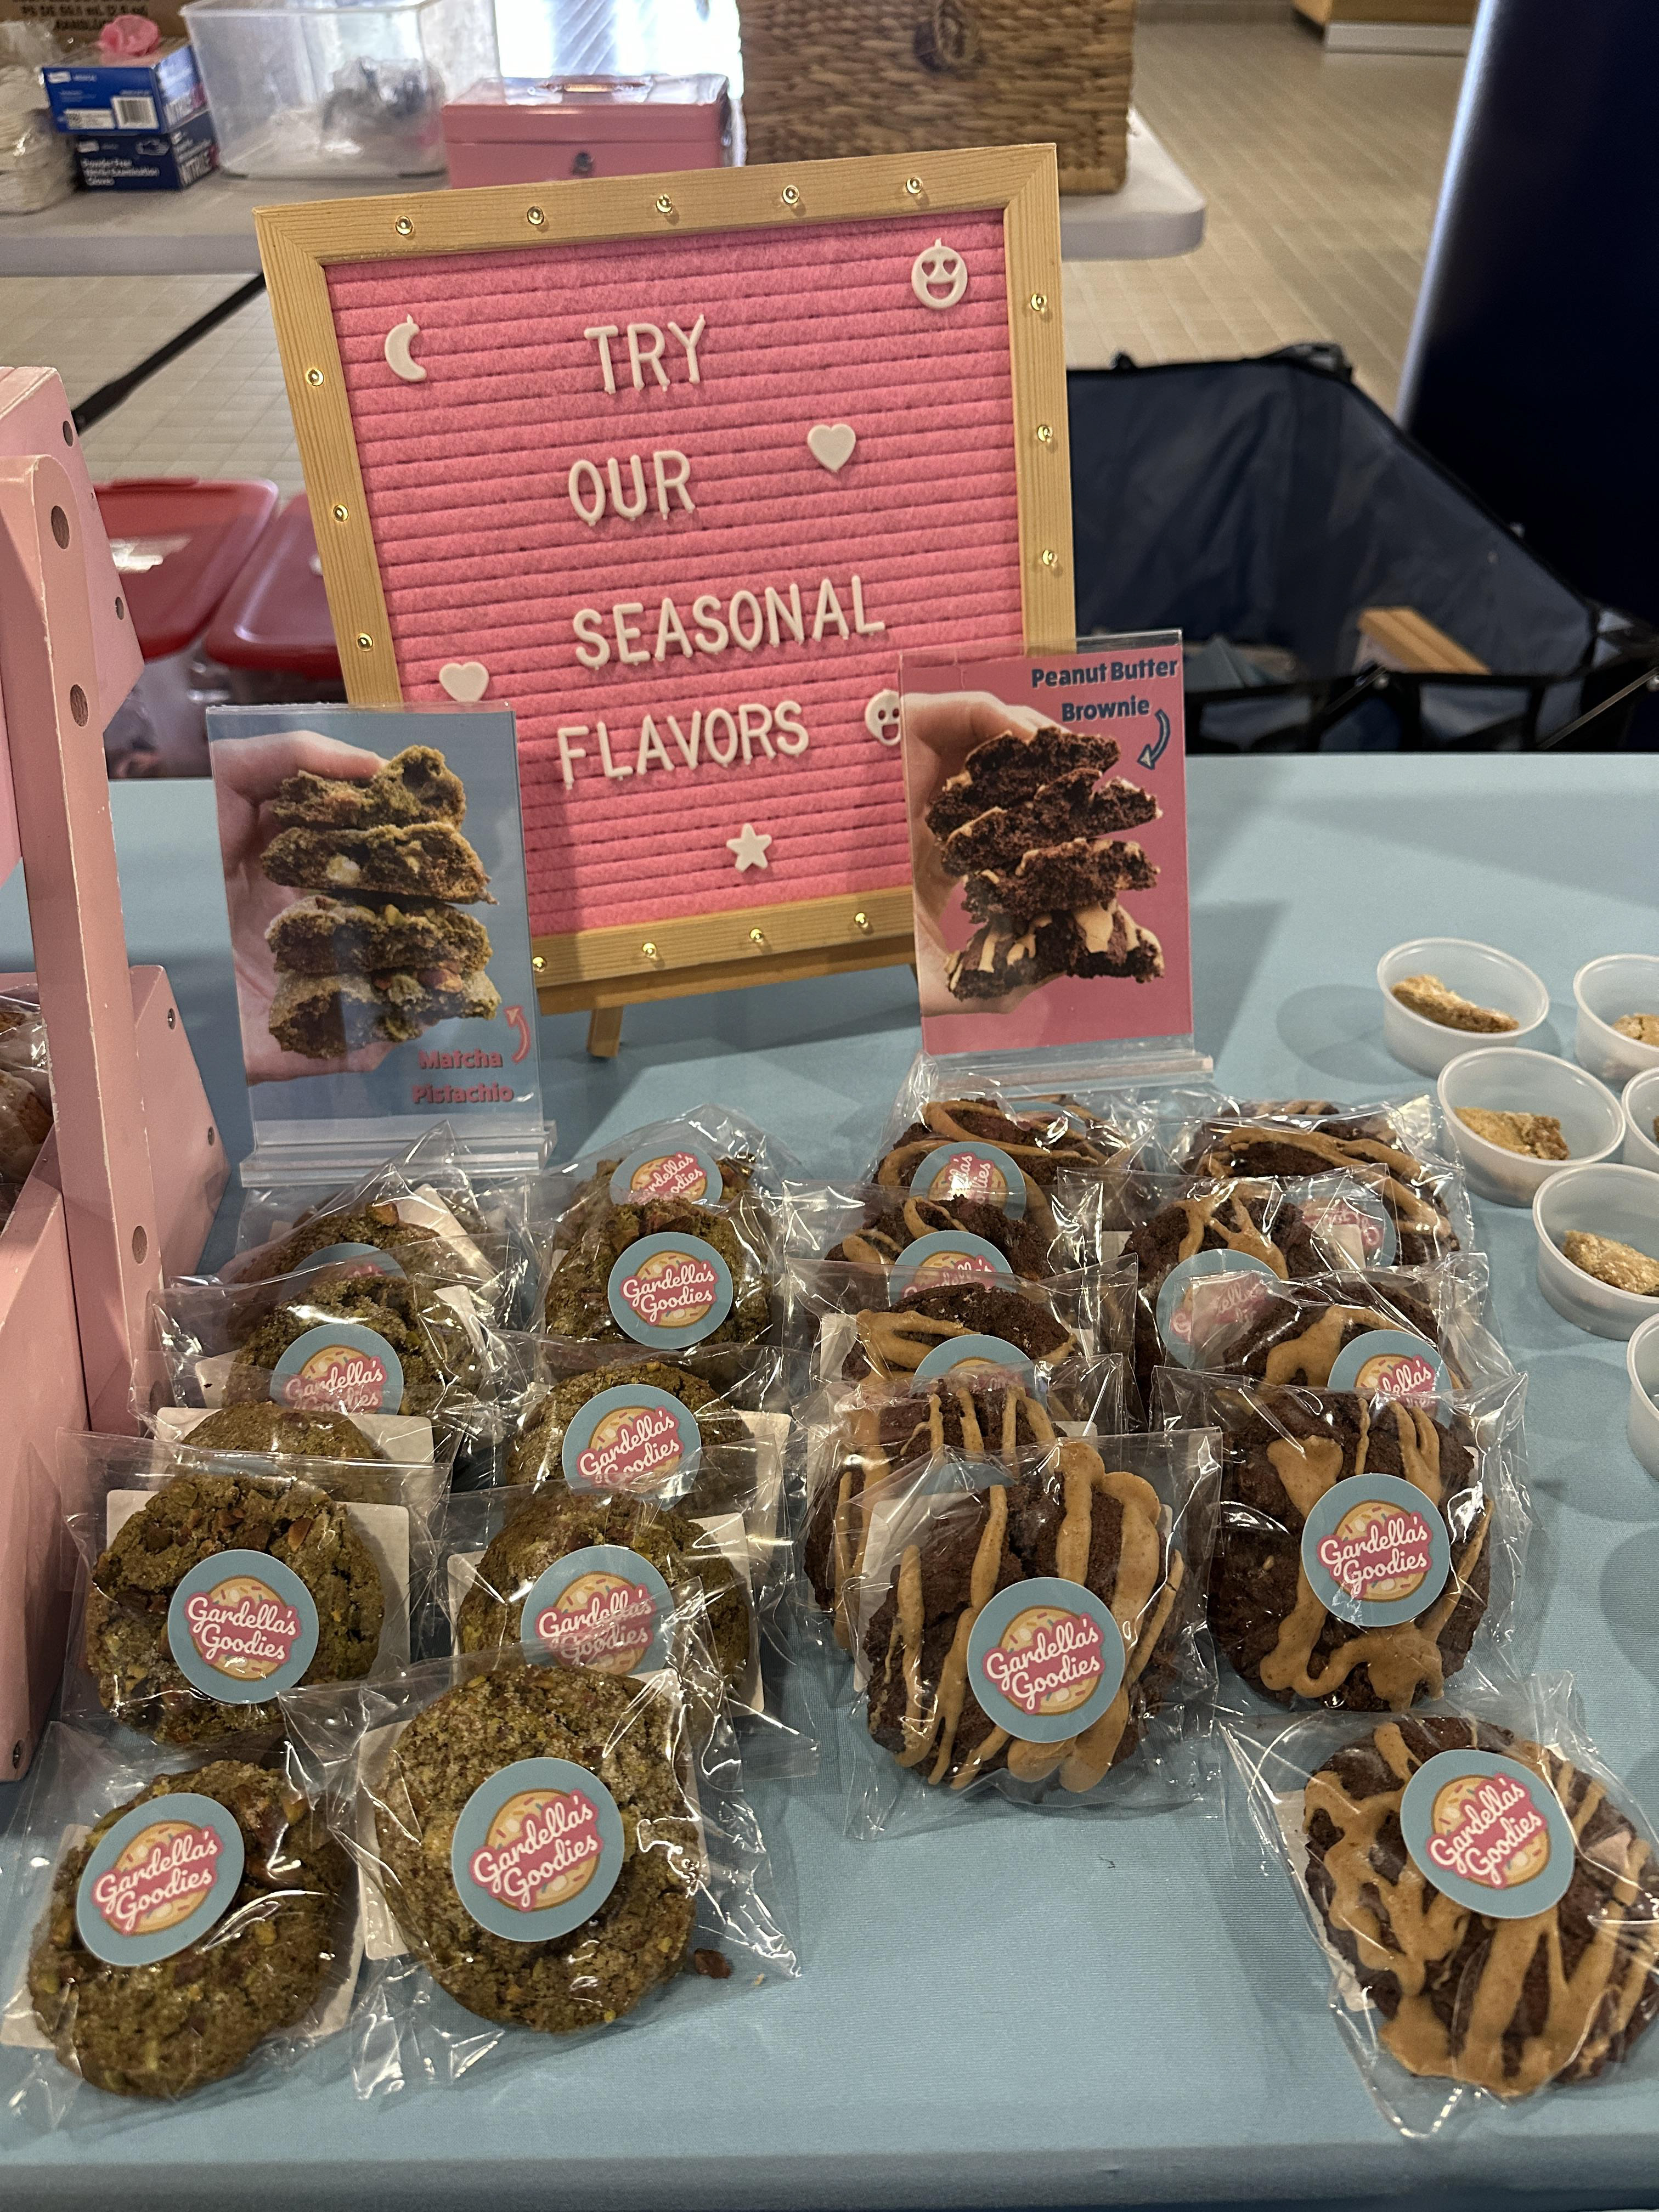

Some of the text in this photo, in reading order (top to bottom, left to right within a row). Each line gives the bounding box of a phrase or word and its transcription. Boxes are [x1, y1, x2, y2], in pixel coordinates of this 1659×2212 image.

[584, 314, 706, 394] TRY
[568, 450, 696, 527] OUR
[573, 574, 885, 670] SEASONAL
[1031, 659, 1178, 689] Peanut Butter
[1061, 695, 1150, 723] Brownie
[557, 700, 809, 790] FLAVORS
[418, 1048, 503, 1069] Matcha
[411, 1081, 514, 1104] Pistachio
[623, 1263, 715, 1307] Gardella's
[640, 1286, 713, 1323] Goodies
[579, 1410, 675, 1483] Gardella's
[1320, 1516, 1428, 1577] Gardella's
[1344, 1548, 1427, 1596] Goodies
[188, 1596, 296, 1636] Gardella's
[201, 1623, 285, 1660] Goodies
[986, 1618, 1099, 1691] Gardella's
[1012, 1655, 1101, 1711] Goodies
[473, 1795, 594, 1894] Gardella's
[1430, 1778, 1526, 1875] Gardella's
[1464, 1811, 1543, 1886] Goodies
[95, 1831, 218, 1914] Gardella's
[115, 1868, 213, 1932] Goodies
[504, 1834, 598, 1908] Goodies
